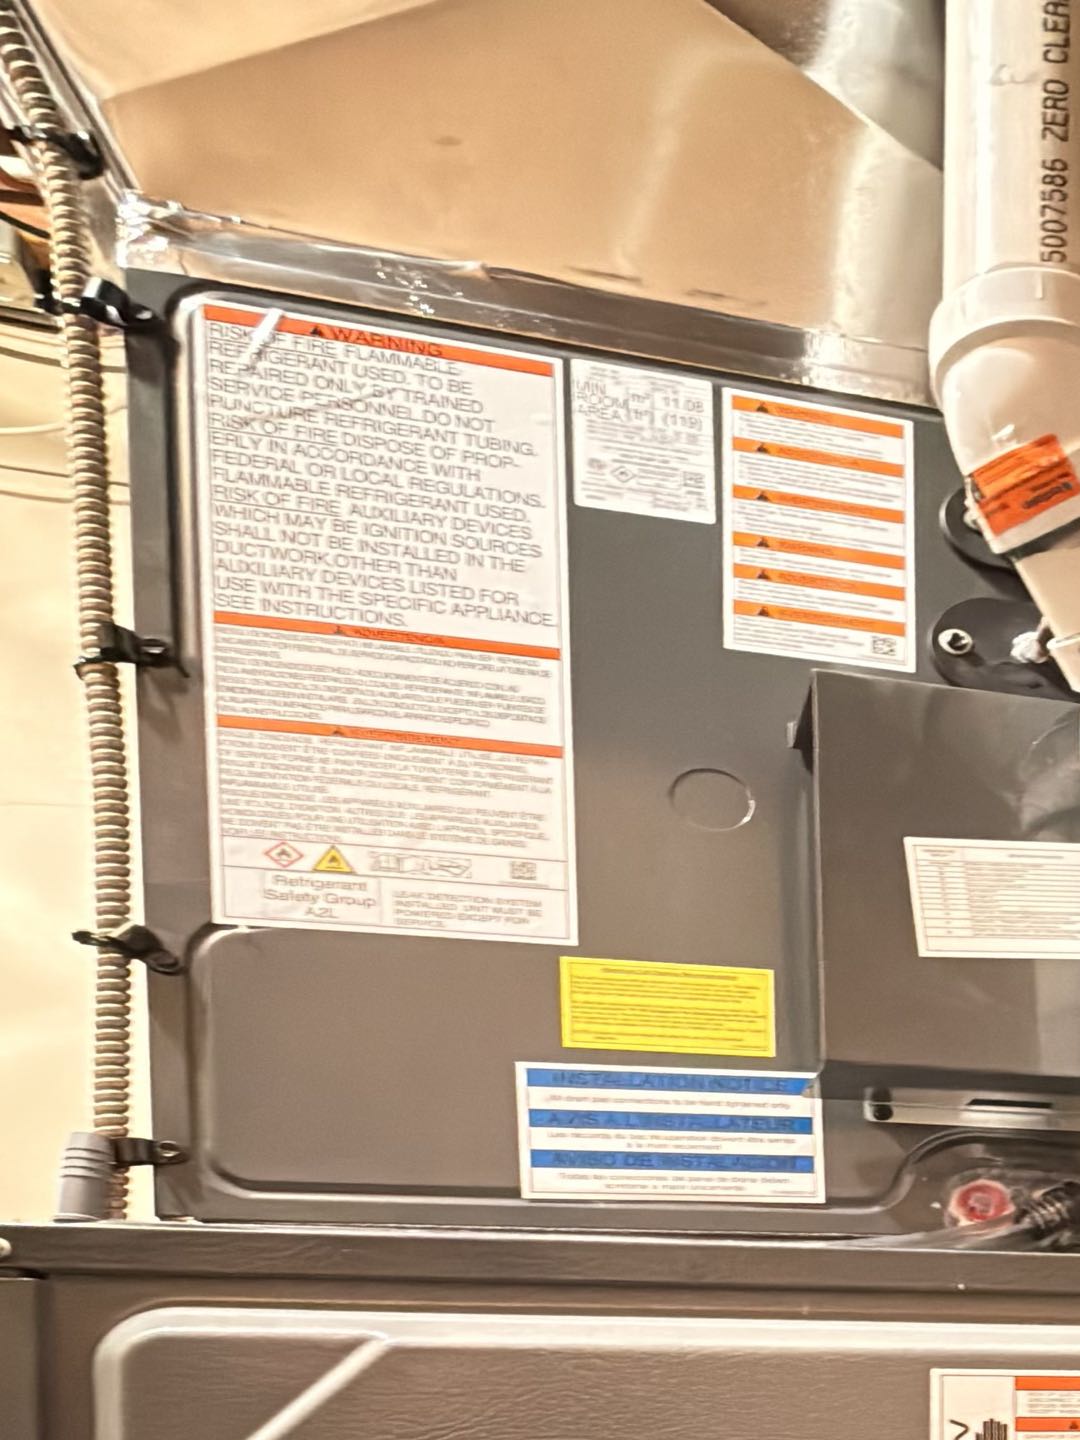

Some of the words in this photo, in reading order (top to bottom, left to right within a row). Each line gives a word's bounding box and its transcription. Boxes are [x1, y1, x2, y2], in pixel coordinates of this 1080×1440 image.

[1042, 0, 1070, 64] CLEA
[1042, 80, 1070, 143] ZERO
[1042, 155, 1069, 264] 5007586
[291, 336, 336, 355] FIRE
[329, 325, 442, 357] WARNING
[209, 376, 294, 402] SERVICE
[423, 409, 451, 427] DO
[454, 414, 495, 434] NOT
[315, 374, 365, 395] ONLY
[398, 388, 483, 414] TRAINED
[414, 373, 443, 390] TO
[446, 378, 472, 395] BE
[210, 394, 319, 423] PUNCTURE
[325, 411, 458, 445] REFRIGERANT
[212, 448, 303, 474] FEDERAL
[307, 462, 335, 478] OR
[339, 466, 403, 488] LOCAL
[263, 419, 288, 436] OF
[294, 424, 338, 444] FIRE
[343, 432, 426, 457] DISPOSE
[430, 445, 457, 461] OF
[462, 449, 521, 471] PROP-
[270, 439, 287, 455] IN
[294, 443, 427, 474] ACCORDANCE
[432, 462, 480, 481] WITH
[212, 466, 331, 495] FLAMMABLE
[335, 483, 471, 514] REFRIGERANT
[213, 484, 259, 504] RISK
[264, 491, 291, 508] OF
[297, 496, 341, 514] FIRE
[350, 503, 447, 528] AUXILIARY
[451, 516, 532, 540] DEVICES
[213, 502, 278, 524] WHICH
[285, 512, 327, 530] MAY
[332, 518, 357, 534] BE
[362, 522, 446, 546] IGNITION
[451, 533, 542, 558] SOURCES
[213, 520, 276, 542] SHALL
[280, 529, 322, 547] NOT
[328, 535, 353, 551] BE
[359, 539, 461, 565] INSTALLED
[464, 552, 484, 567] IN
[488, 555, 526, 572] THE
[214, 557, 316, 581] AUXILIARY
[321, 569, 405, 592] DEVICES
[409, 580, 475, 600] LISTED
[479, 588, 519, 606] FOR
[335, 553, 400, 574] OTHER
[404, 561, 458, 581] THAN
[214, 592, 255, 610] SEE
[216, 575, 256, 593] USE
[261, 580, 312, 598] WITH
[314, 586, 354, 604] THE
[358, 591, 447, 615] SPECIFIC
[263, 888, 318, 903] Safety
[325, 892, 376, 909] Group
